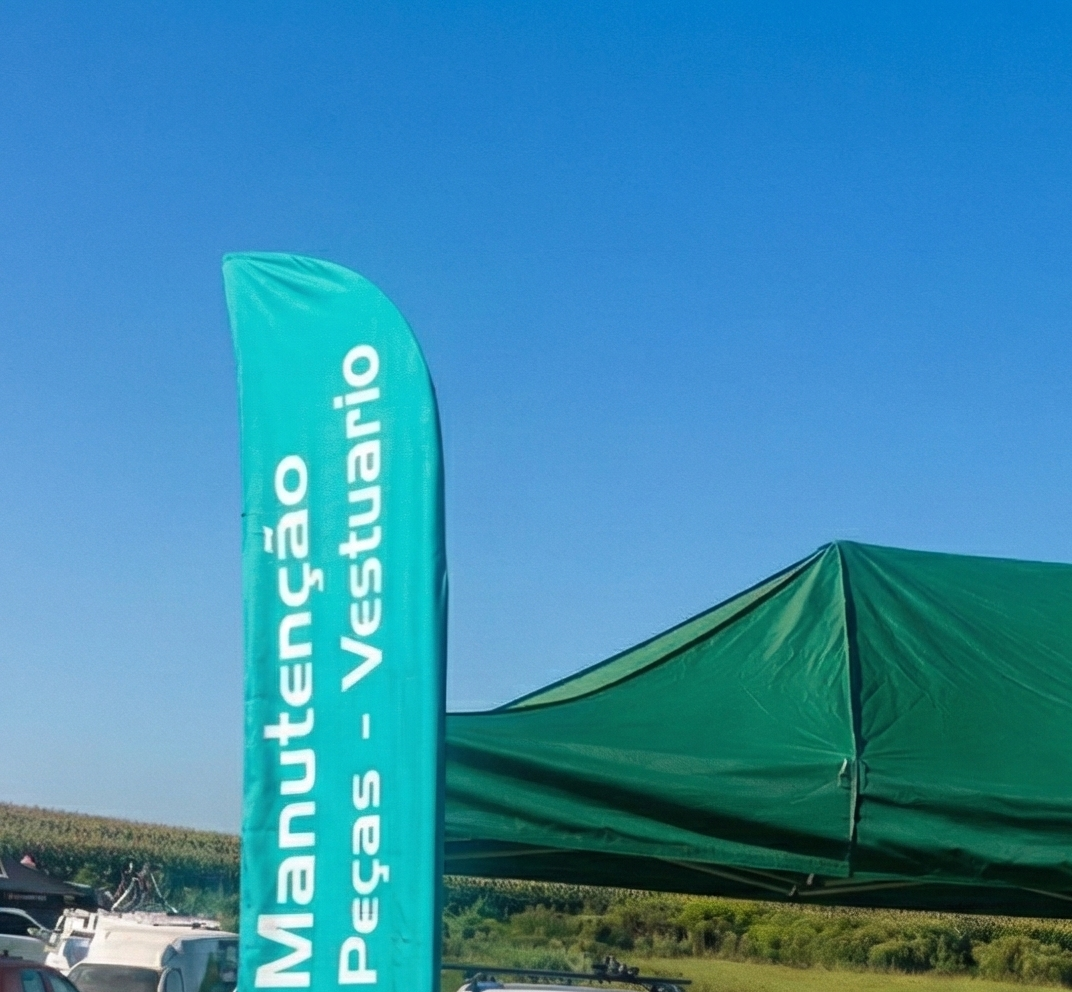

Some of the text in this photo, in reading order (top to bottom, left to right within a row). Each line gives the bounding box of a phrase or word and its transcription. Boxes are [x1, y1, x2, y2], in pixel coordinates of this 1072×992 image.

[333, 344, 382, 691] Vestuario
[255, 454, 324, 988] Manutenção
[338, 770, 390, 985] Peças
